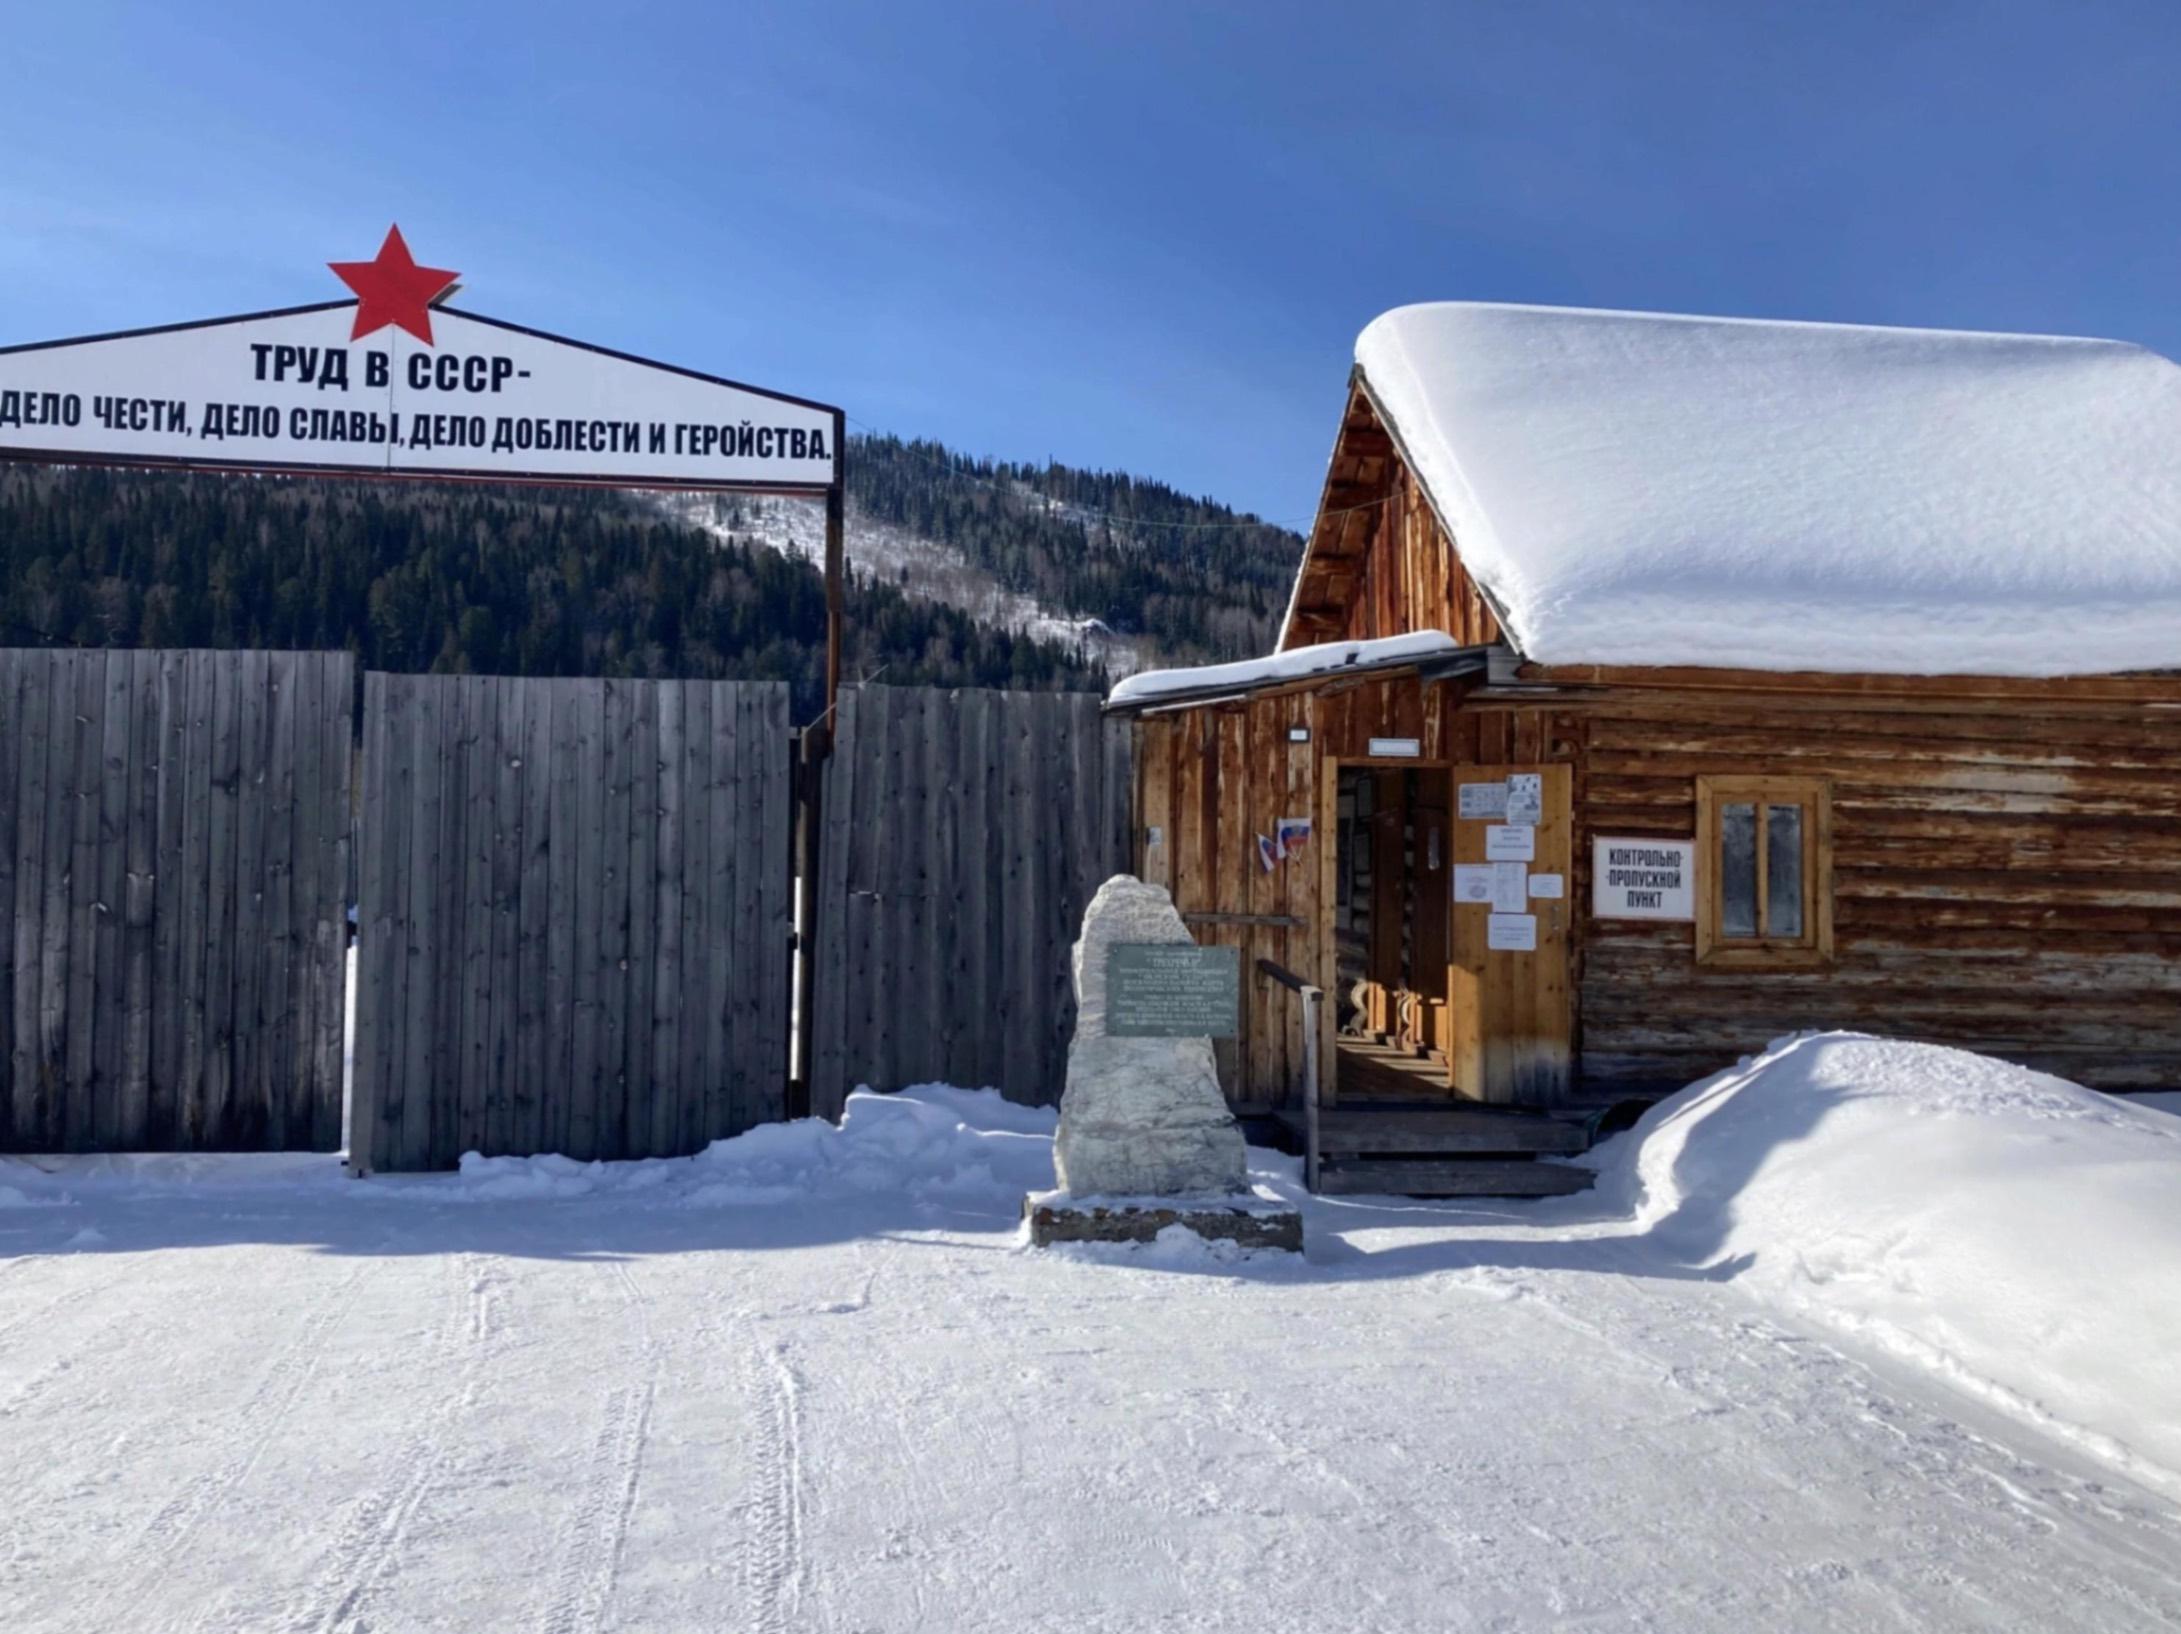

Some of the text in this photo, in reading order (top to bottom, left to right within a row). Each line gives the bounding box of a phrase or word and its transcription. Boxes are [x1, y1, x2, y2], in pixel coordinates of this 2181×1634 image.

[251, 343, 531, 393] ТРУД В СССР-
[0, 390, 833, 460] ДЕЛО ЧЕСТИ, ДЕЛО СЛАВЫ, ДЕЛО ДОБЛЕСТИ И ГЕРОЙСТВА.
[1626, 889, 1663, 909] ПУНКТ
